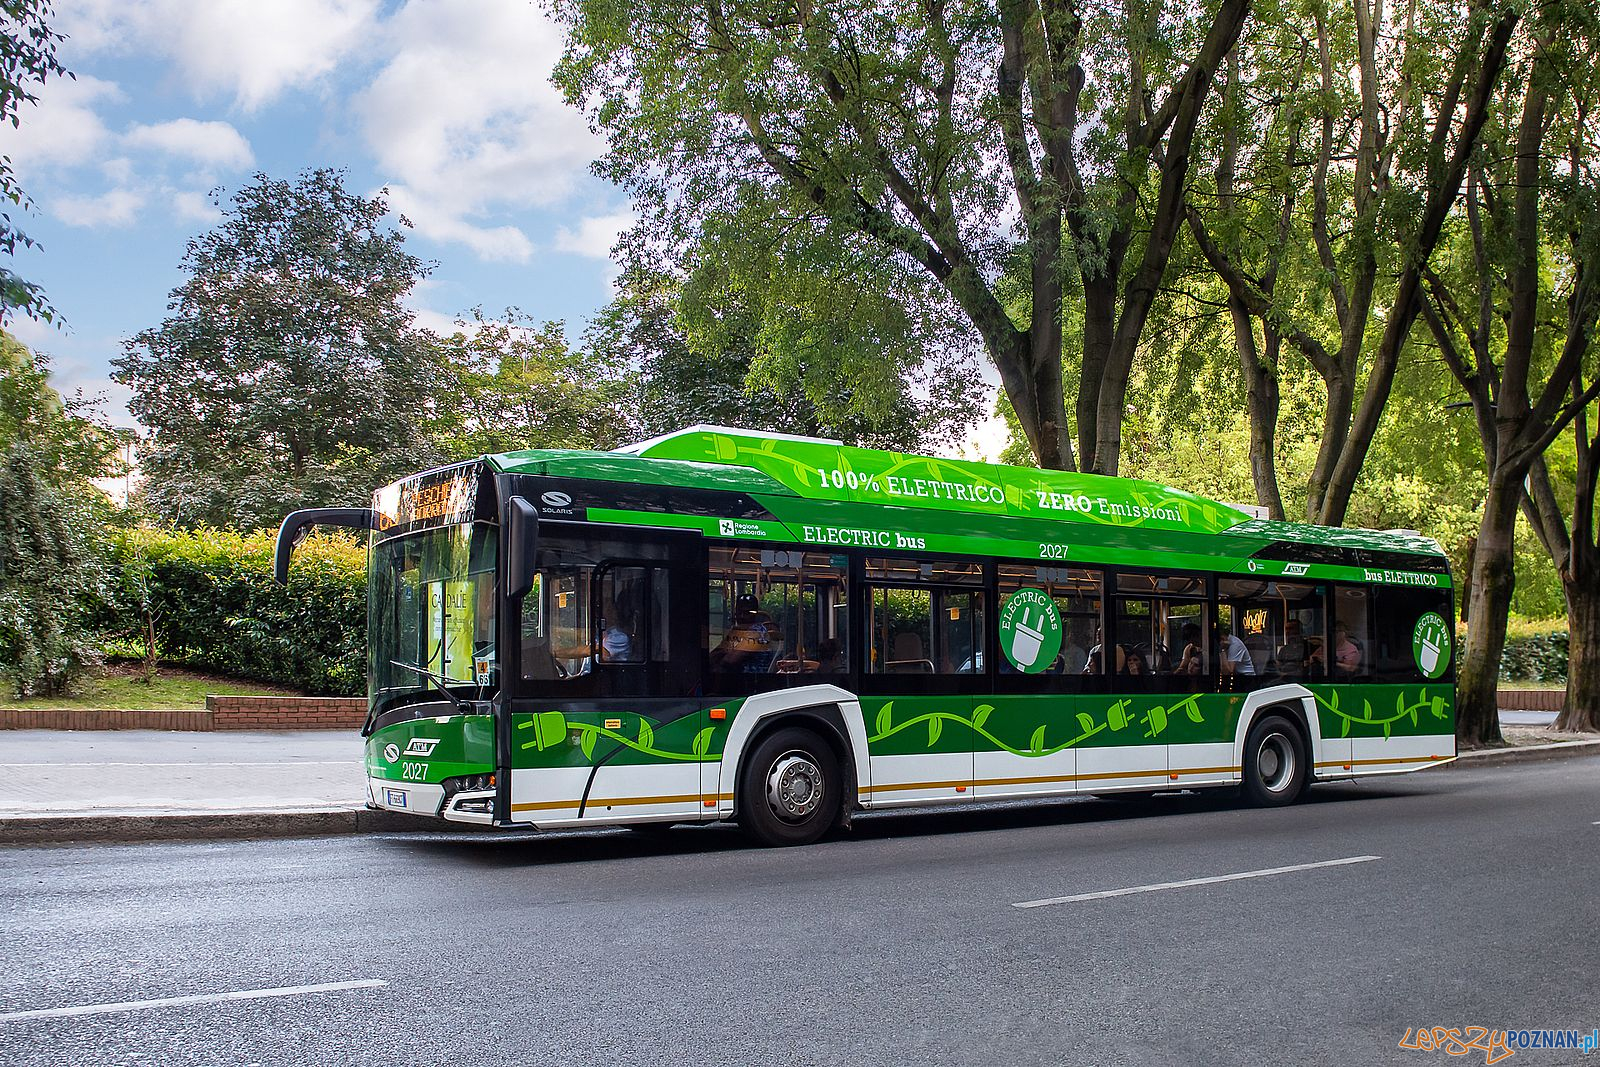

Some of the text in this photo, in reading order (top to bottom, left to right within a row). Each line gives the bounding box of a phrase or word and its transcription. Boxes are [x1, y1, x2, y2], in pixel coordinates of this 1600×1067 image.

[818, 469, 1005, 504] 100% ELETTRICO
[1036, 491, 1183, 522] ZERO Emissioni
[803, 526, 926, 549] ELECTRIC bus
[1039, 544, 1069, 558] 2027
[1364, 569, 1438, 586] bus ELETTRICO
[1002, 591, 1058, 631] ELECTRIC bus
[1414, 615, 1449, 647] ELECTRIC bus
[402, 761, 428, 780] 2027
